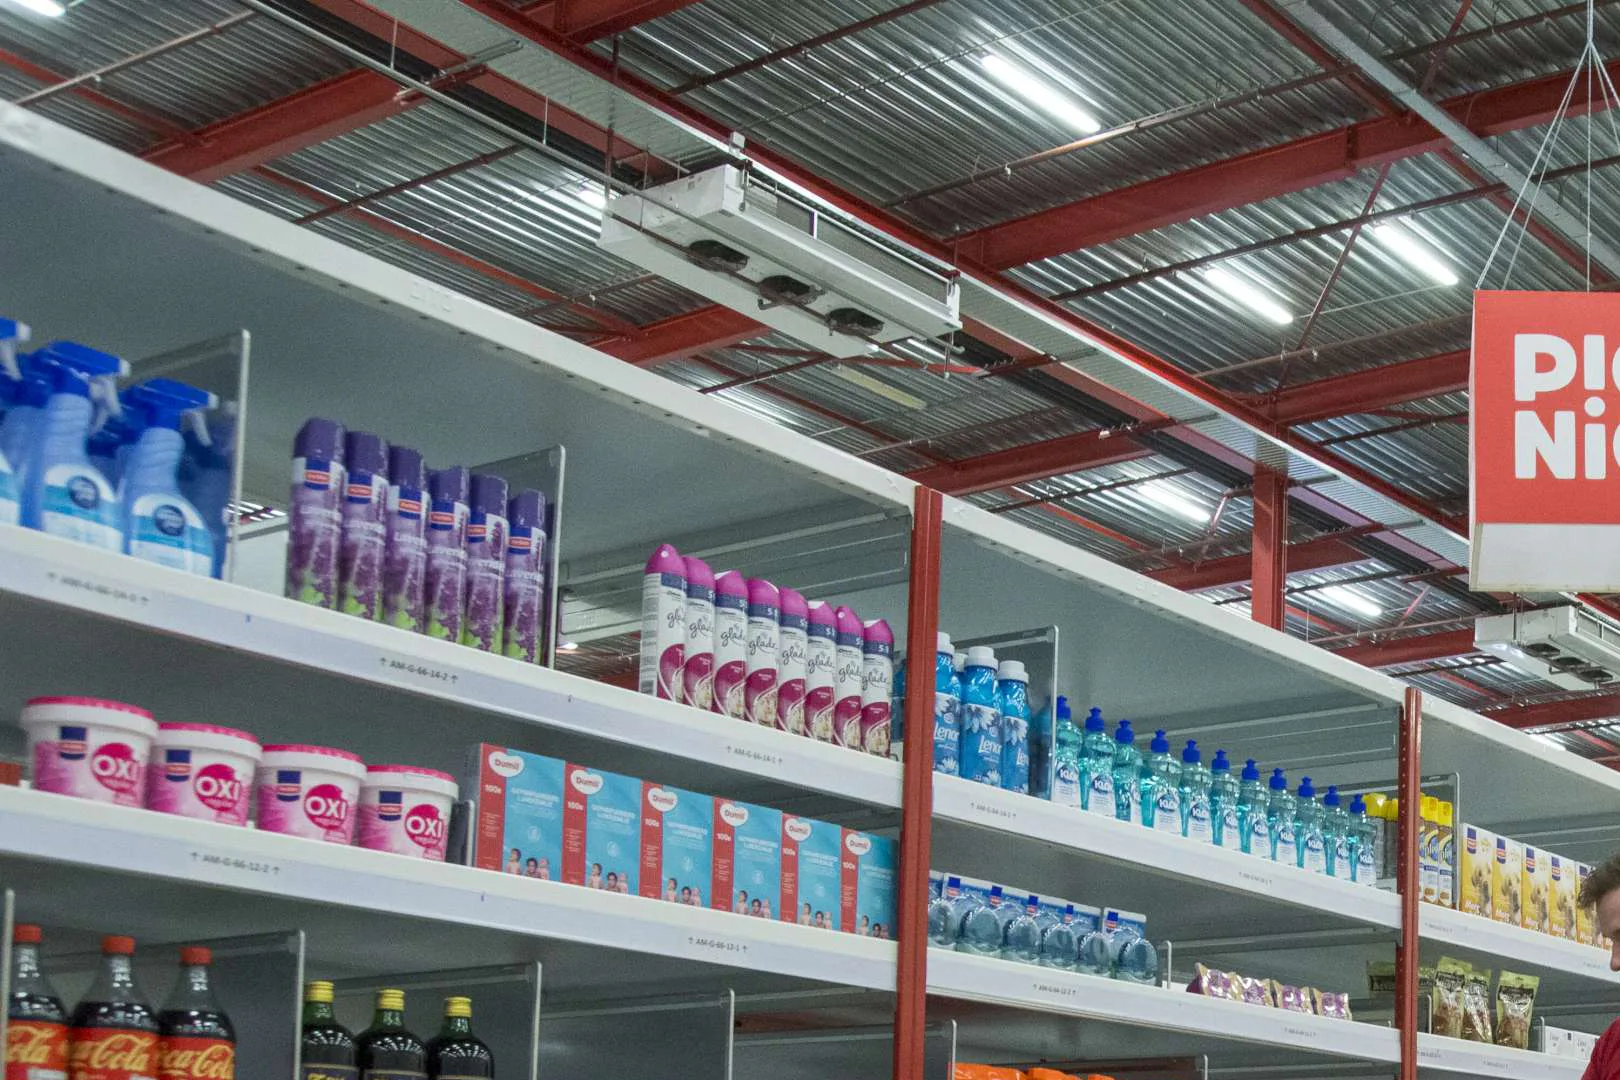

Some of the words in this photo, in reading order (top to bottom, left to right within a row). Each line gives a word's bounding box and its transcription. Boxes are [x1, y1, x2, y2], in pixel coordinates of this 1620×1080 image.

[92, 753, 139, 782] OXI
[195, 776, 240, 802] OXI
[305, 795, 347, 819] OXI
[405, 813, 443, 837] OXI
